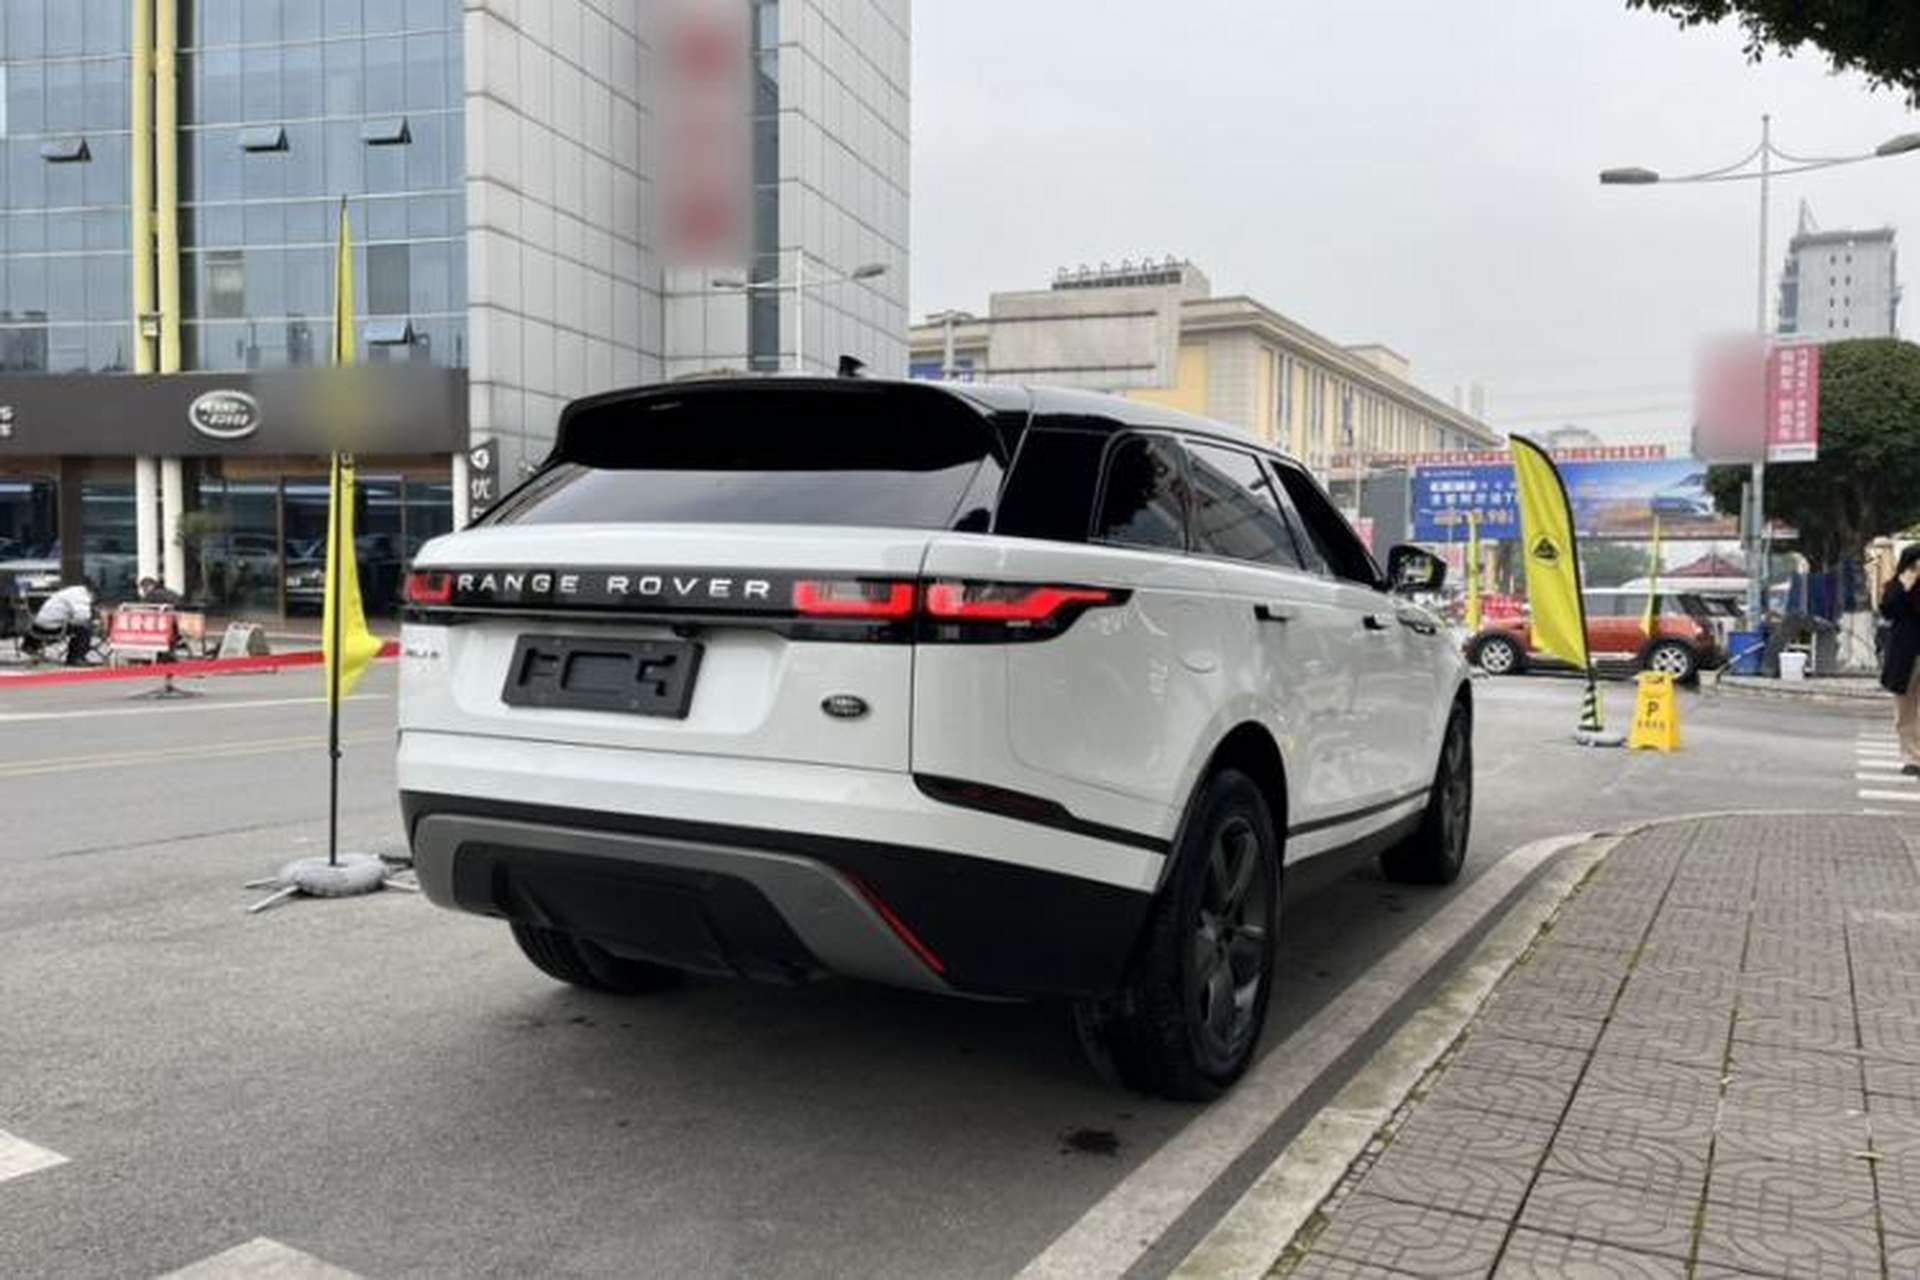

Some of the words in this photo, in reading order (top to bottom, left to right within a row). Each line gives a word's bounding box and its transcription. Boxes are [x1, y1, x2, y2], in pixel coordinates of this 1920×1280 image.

[456, 573, 579, 594] RANGE
[606, 575, 771, 599] ROVER
[1646, 700, 1660, 718] P
